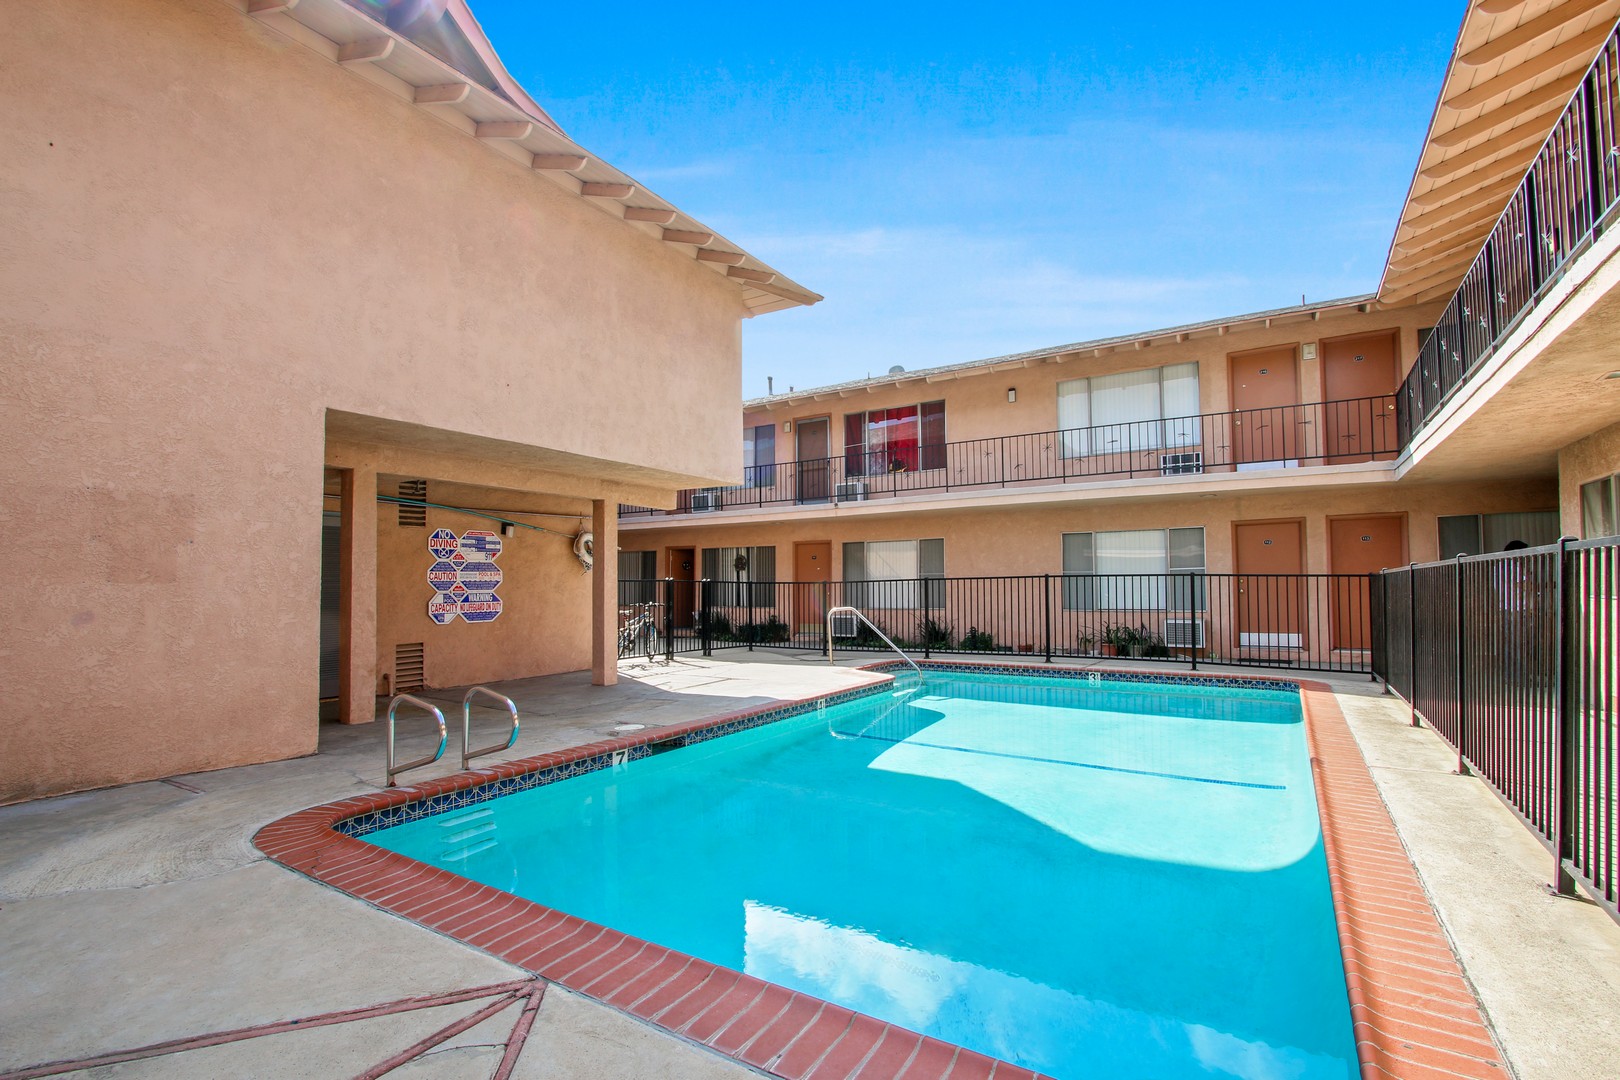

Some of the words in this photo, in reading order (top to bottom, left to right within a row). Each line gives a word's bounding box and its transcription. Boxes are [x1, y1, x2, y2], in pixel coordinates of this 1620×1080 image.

[438, 530, 451, 539] NO
[430, 539, 458, 548] DIVING
[428, 572, 457, 581] CAUTION
[468, 593, 493, 602] WARNING
[431, 604, 457, 612] CAPACITY
[460, 604, 466, 612] NO
[466, 603, 484, 612] LIFEGUARD
[616, 751, 626, 765] 7
